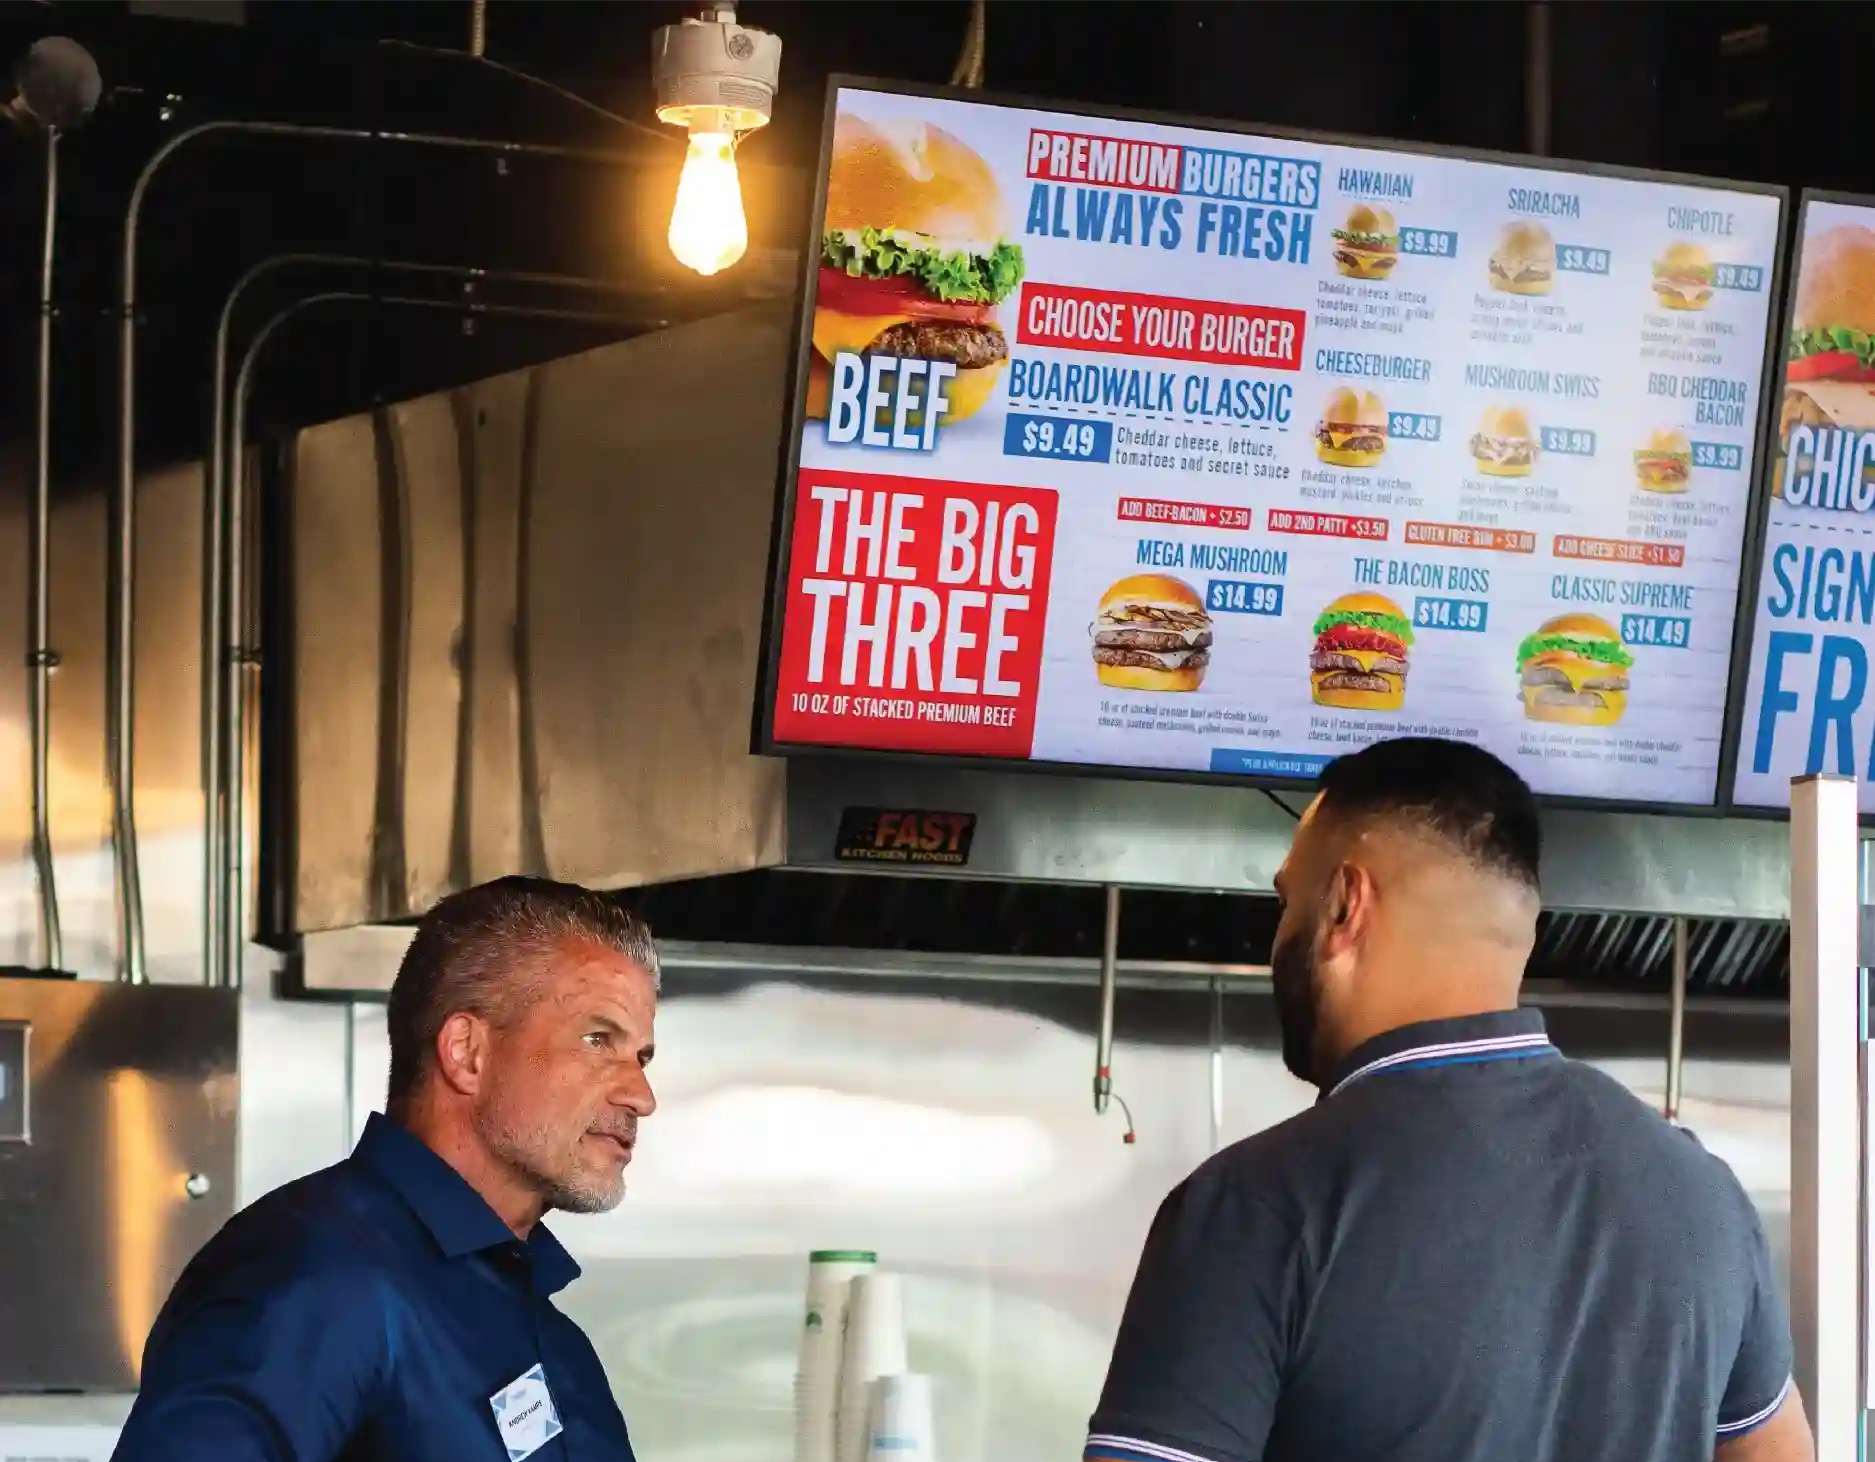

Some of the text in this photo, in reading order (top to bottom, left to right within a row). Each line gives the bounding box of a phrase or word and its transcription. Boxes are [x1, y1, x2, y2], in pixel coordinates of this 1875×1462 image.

[1029, 131, 1319, 207] PREMIUM BURGERS
[1338, 167, 1414, 198] HAWAIIAN
[1508, 187, 1581, 219] SRIRACHA
[1025, 183, 1315, 265] ALWAYS FRESH
[1667, 205, 1735, 237] CHIPOTLE
[1404, 231, 1450, 255] $9.99
[1563, 249, 1607, 272] $9.49
[1716, 266, 1760, 289] $9.49
[1028, 295, 1297, 361] CHOOSE YOUR BURGER
[1315, 349, 1432, 382] CHEESEBURGER
[1464, 364, 1601, 399] MUSHROOM SWISS
[828, 352, 957, 450] BEEF
[1008, 357, 1294, 425] BOARDWALK CLASSIC
[1681, 376, 1749, 404] CHEDDAR
[1392, 415, 1437, 440] $9.49
[1695, 401, 1746, 427] BACON
[1022, 420, 1096, 457] $9.49
[1116, 425, 1278, 461] Cheddar cheese, lettuce,
[1549, 430, 1592, 454] $9.99
[1115, 449, 1291, 481] tomatoes and secret sauce
[1695, 446, 1738, 467] $9.99
[1121, 501, 1143, 517] ADD
[1145, 503, 1208, 523] BEEF-BACON
[1218, 509, 1249, 527] $2.50
[1271, 513, 1292, 530] ADD
[1294, 515, 1316, 531] 2ND
[1317, 517, 1349, 535] PATTY
[811, 485, 1040, 590] THE BIG
[1408, 523, 1445, 542] GLUTEN
[1447, 526, 1470, 545] FREE
[1136, 539, 1289, 577] MEGA MUSHROOM
[1558, 540, 1578, 555] ADD
[1579, 541, 1616, 558] CHEESE
[1617, 544, 1645, 561] SLICE
[1353, 557, 1490, 593] THE BACON BOSS
[1212, 583, 1278, 611] $14.99
[1551, 574, 1695, 611] CLASSIC SUPREME
[1418, 602, 1482, 628] $14.99
[1624, 616, 1685, 646] $14.49
[801, 577, 1030, 697] THREE
[792, 692, 1017, 727] 10 OZ OF STACKED PREMIUM BEEF
[874, 811, 969, 851] FAST
[841, 847, 964, 863] KITCHEN HOODS
